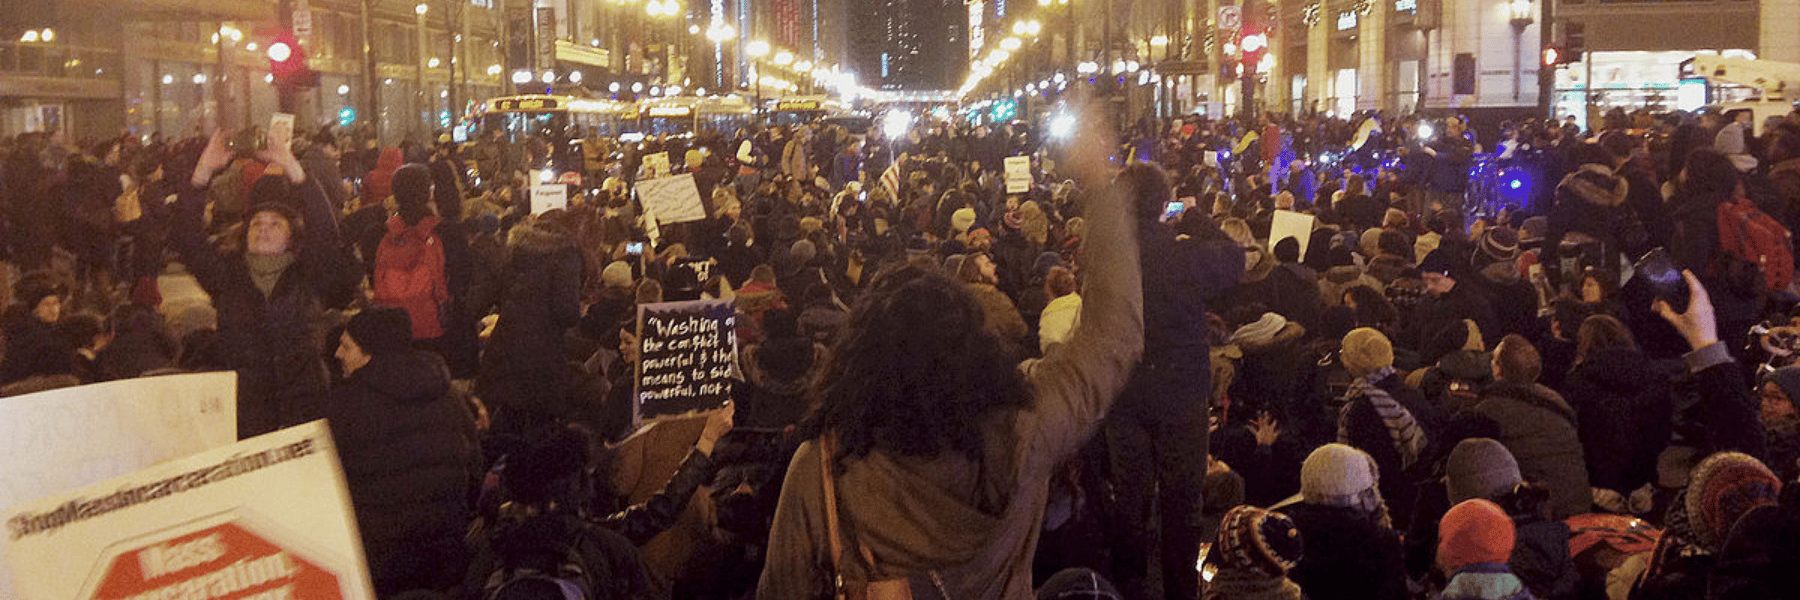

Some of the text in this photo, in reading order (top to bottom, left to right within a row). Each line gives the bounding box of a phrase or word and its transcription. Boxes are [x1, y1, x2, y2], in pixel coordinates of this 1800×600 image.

[643, 336, 663, 353] the
[668, 332, 720, 351] conflict
[642, 352, 693, 374] powerful
[642, 371, 685, 387] means
[692, 368, 705, 381] to
[640, 383, 697, 404] powerful,
[700, 382, 722, 395] not
